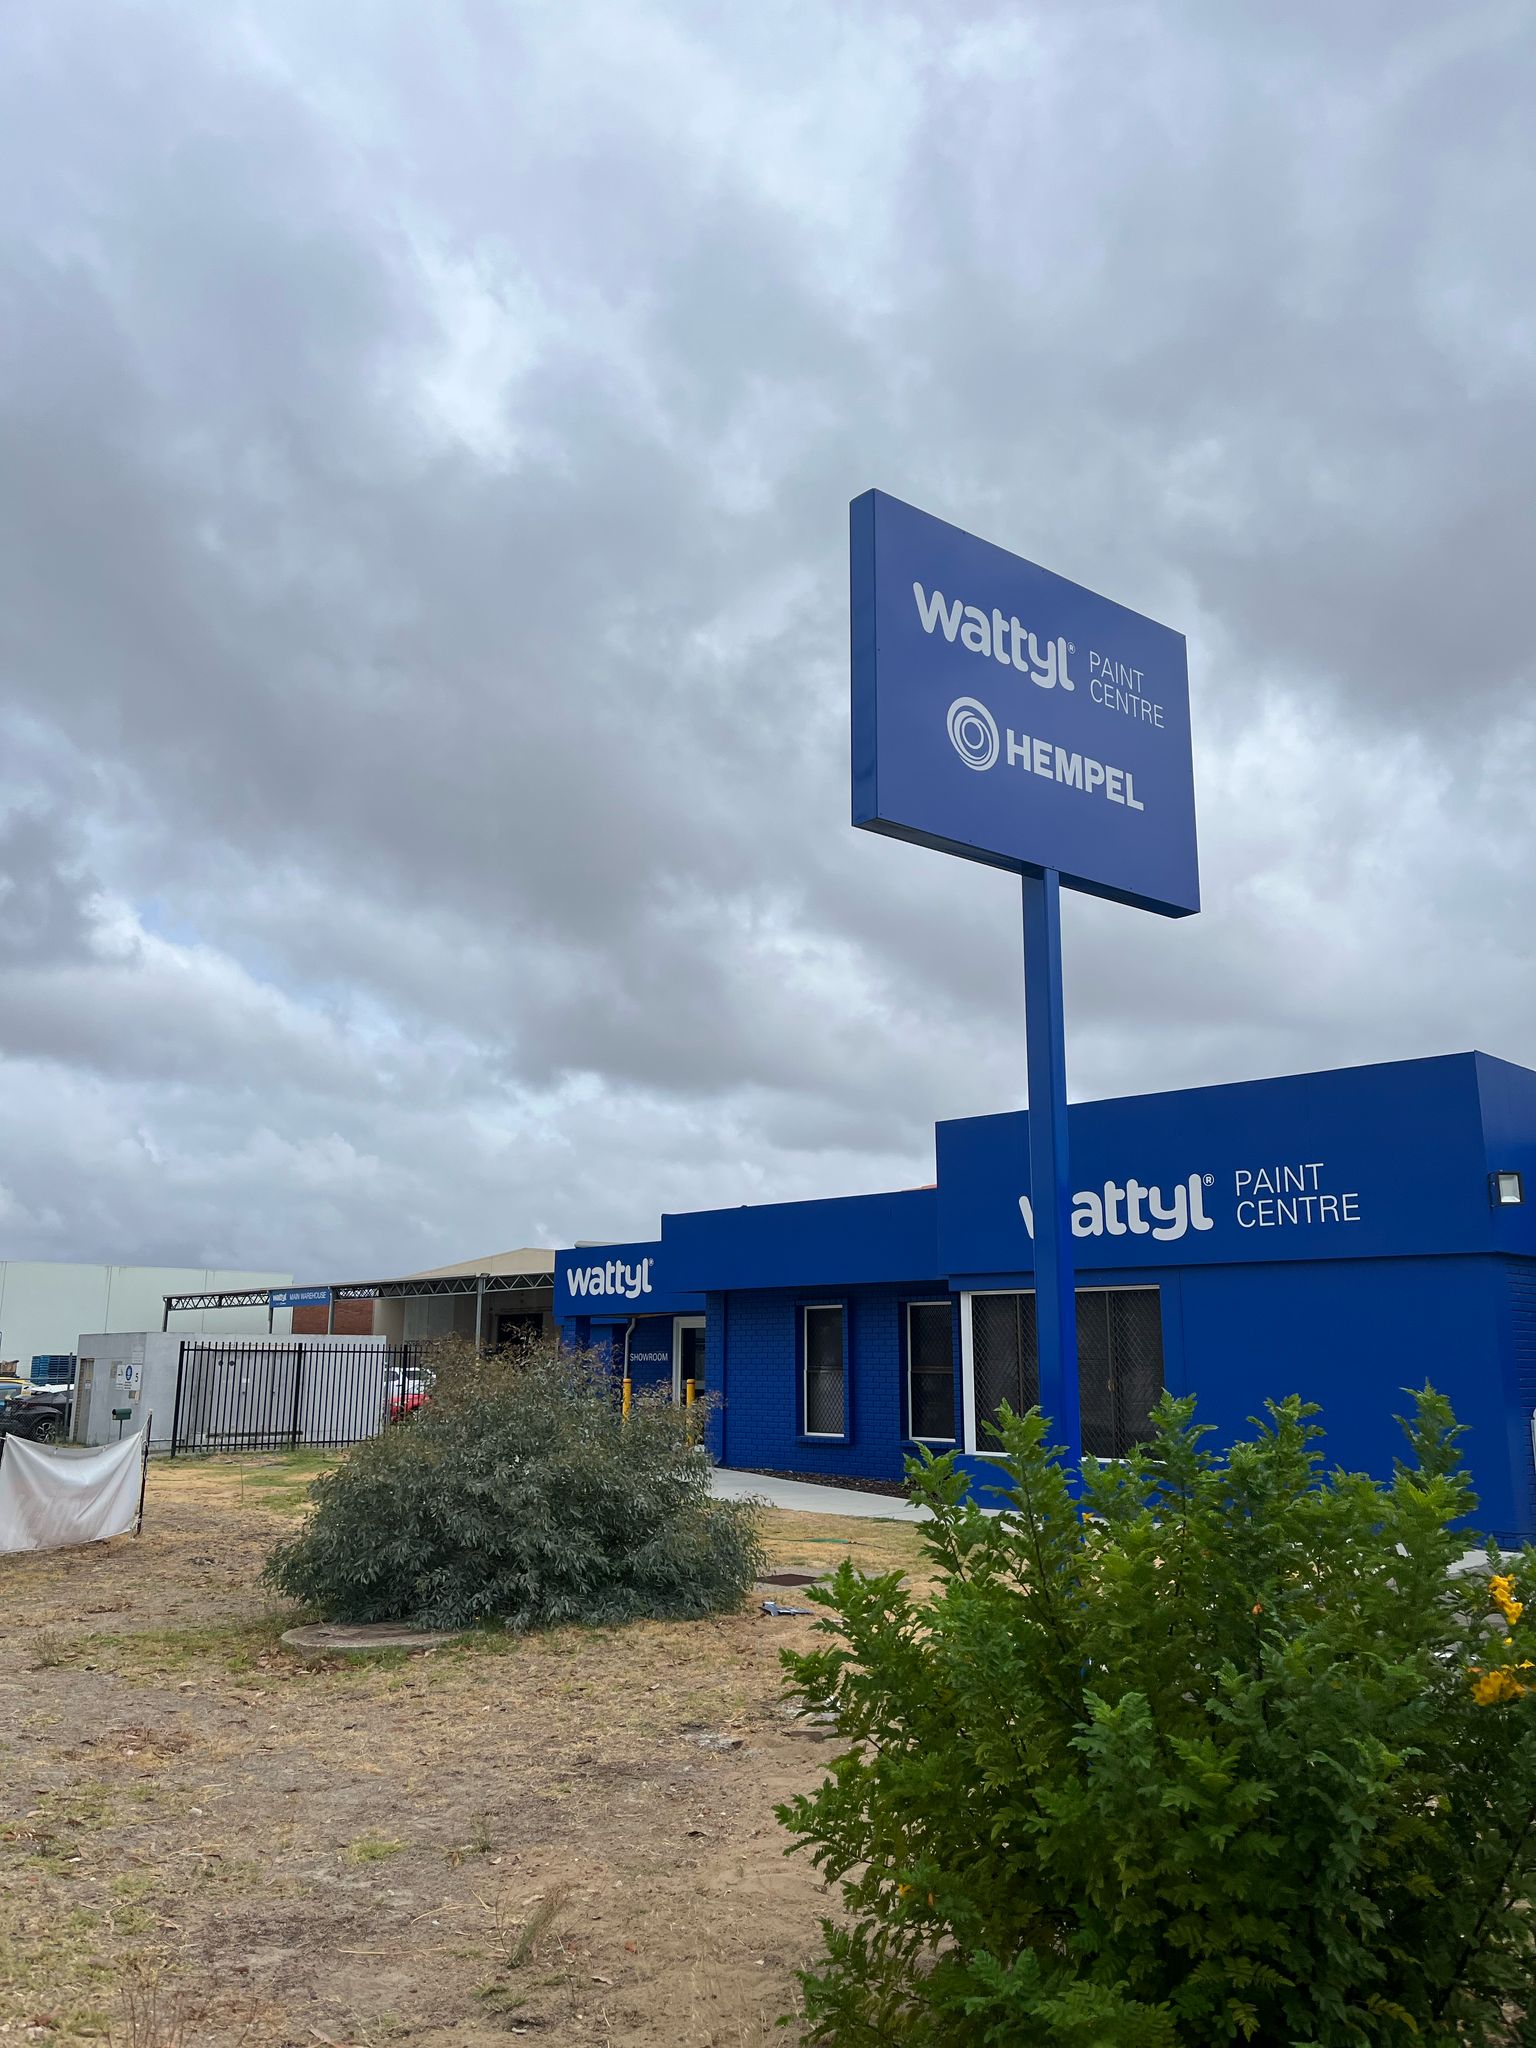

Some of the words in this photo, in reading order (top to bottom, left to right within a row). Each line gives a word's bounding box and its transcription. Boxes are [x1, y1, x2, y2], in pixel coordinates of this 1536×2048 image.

[1089, 651, 1144, 693] PAINT
[1090, 679, 1165, 729] CENTRE
[1006, 728, 1145, 811] HEMPEL
[1235, 1163, 1324, 1196] PAINT
[1018, 1173, 1214, 1241] attyl
[1236, 1193, 1361, 1228] CENTRE
[289, 1293, 300, 1301] MAIN
[300, 1291, 327, 1300] WAREHOUSE
[629, 1352, 669, 1362] SHOWROOM
